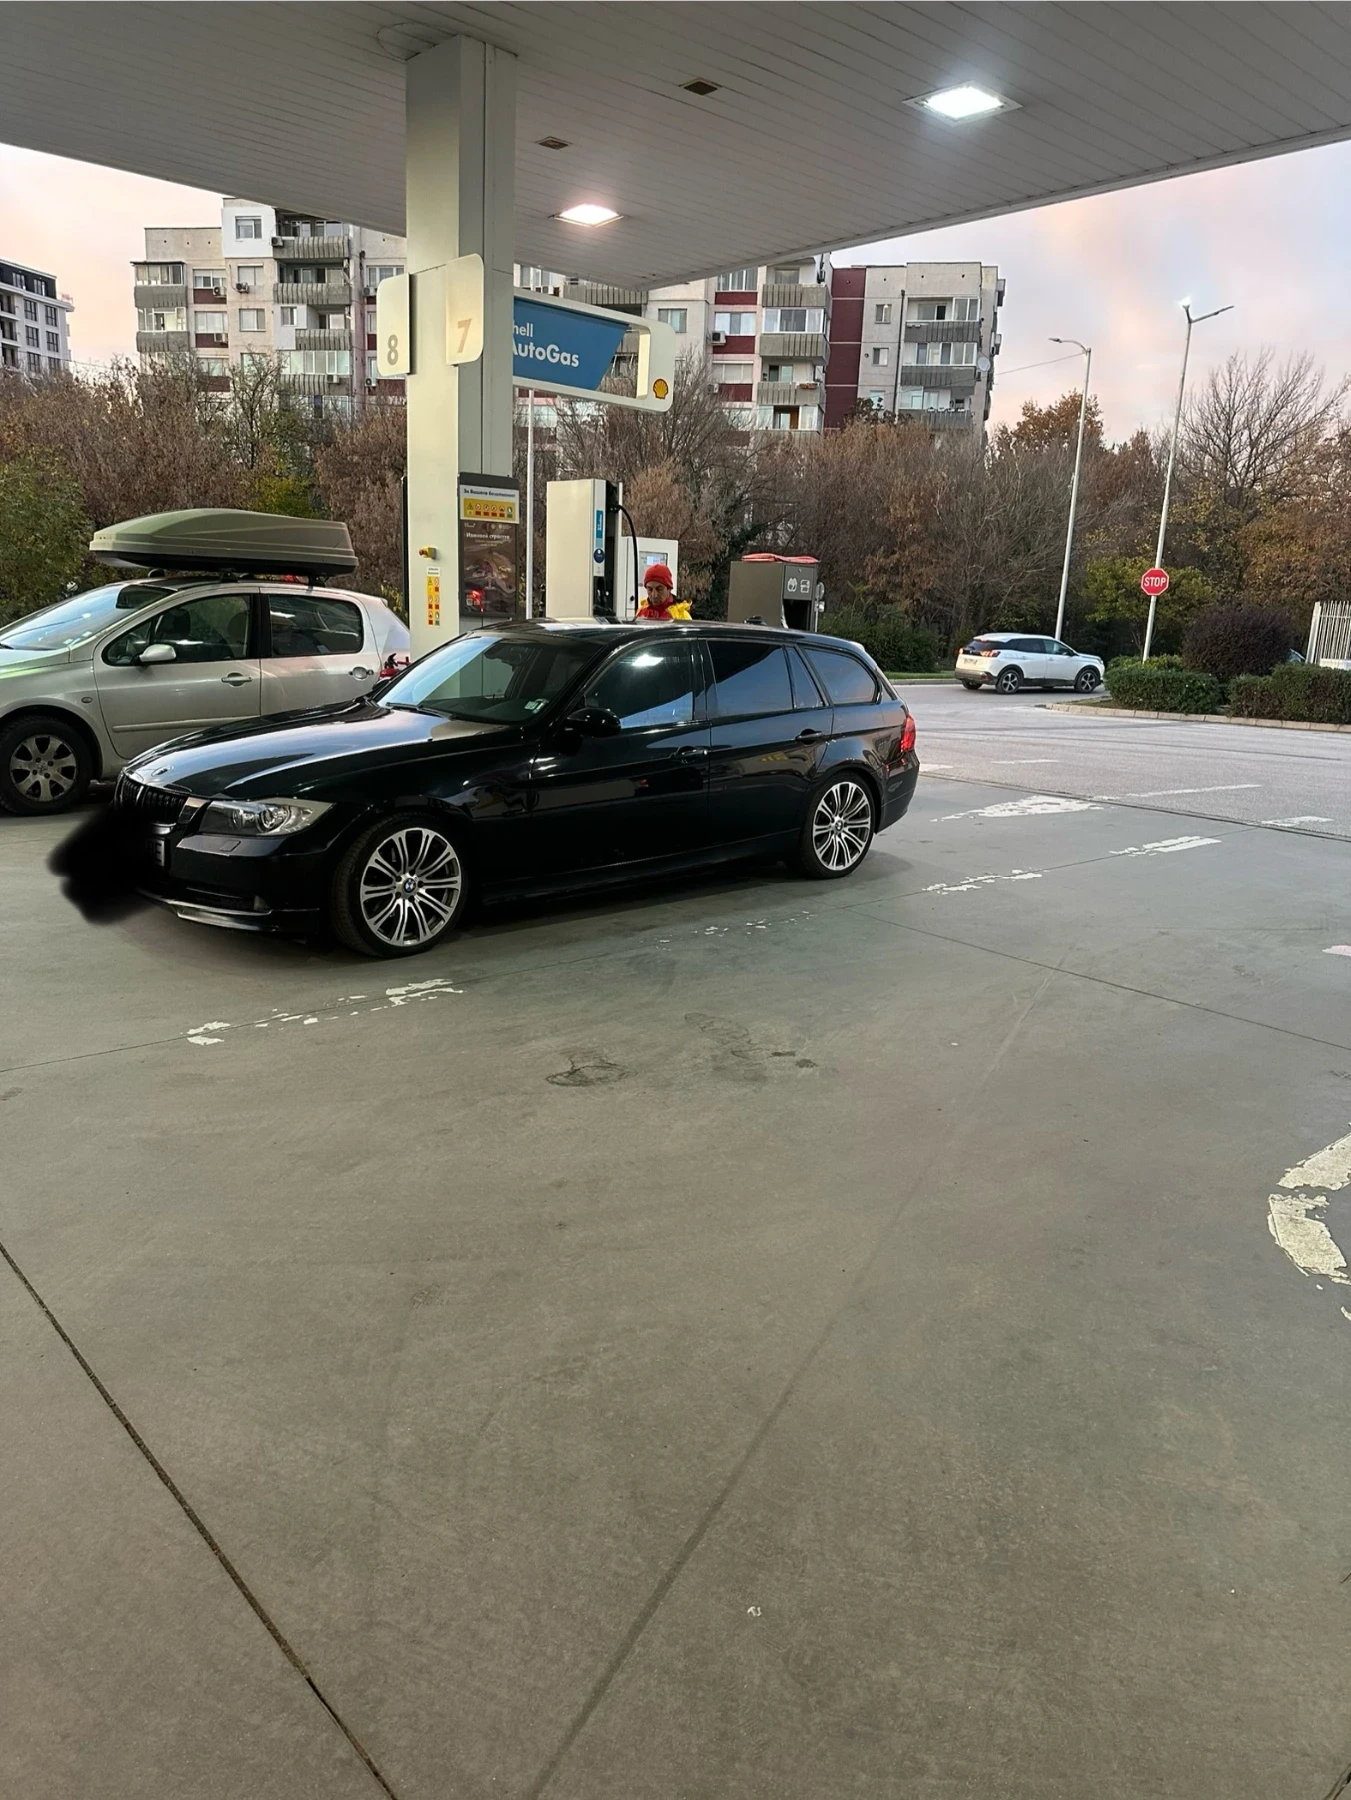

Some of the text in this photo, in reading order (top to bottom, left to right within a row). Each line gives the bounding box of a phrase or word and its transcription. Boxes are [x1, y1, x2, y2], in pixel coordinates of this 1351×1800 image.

[457, 318, 472, 354] 7
[512, 322, 534, 337] hell
[387, 334, 399, 366] 8
[1144, 576, 1166, 587] STOP
